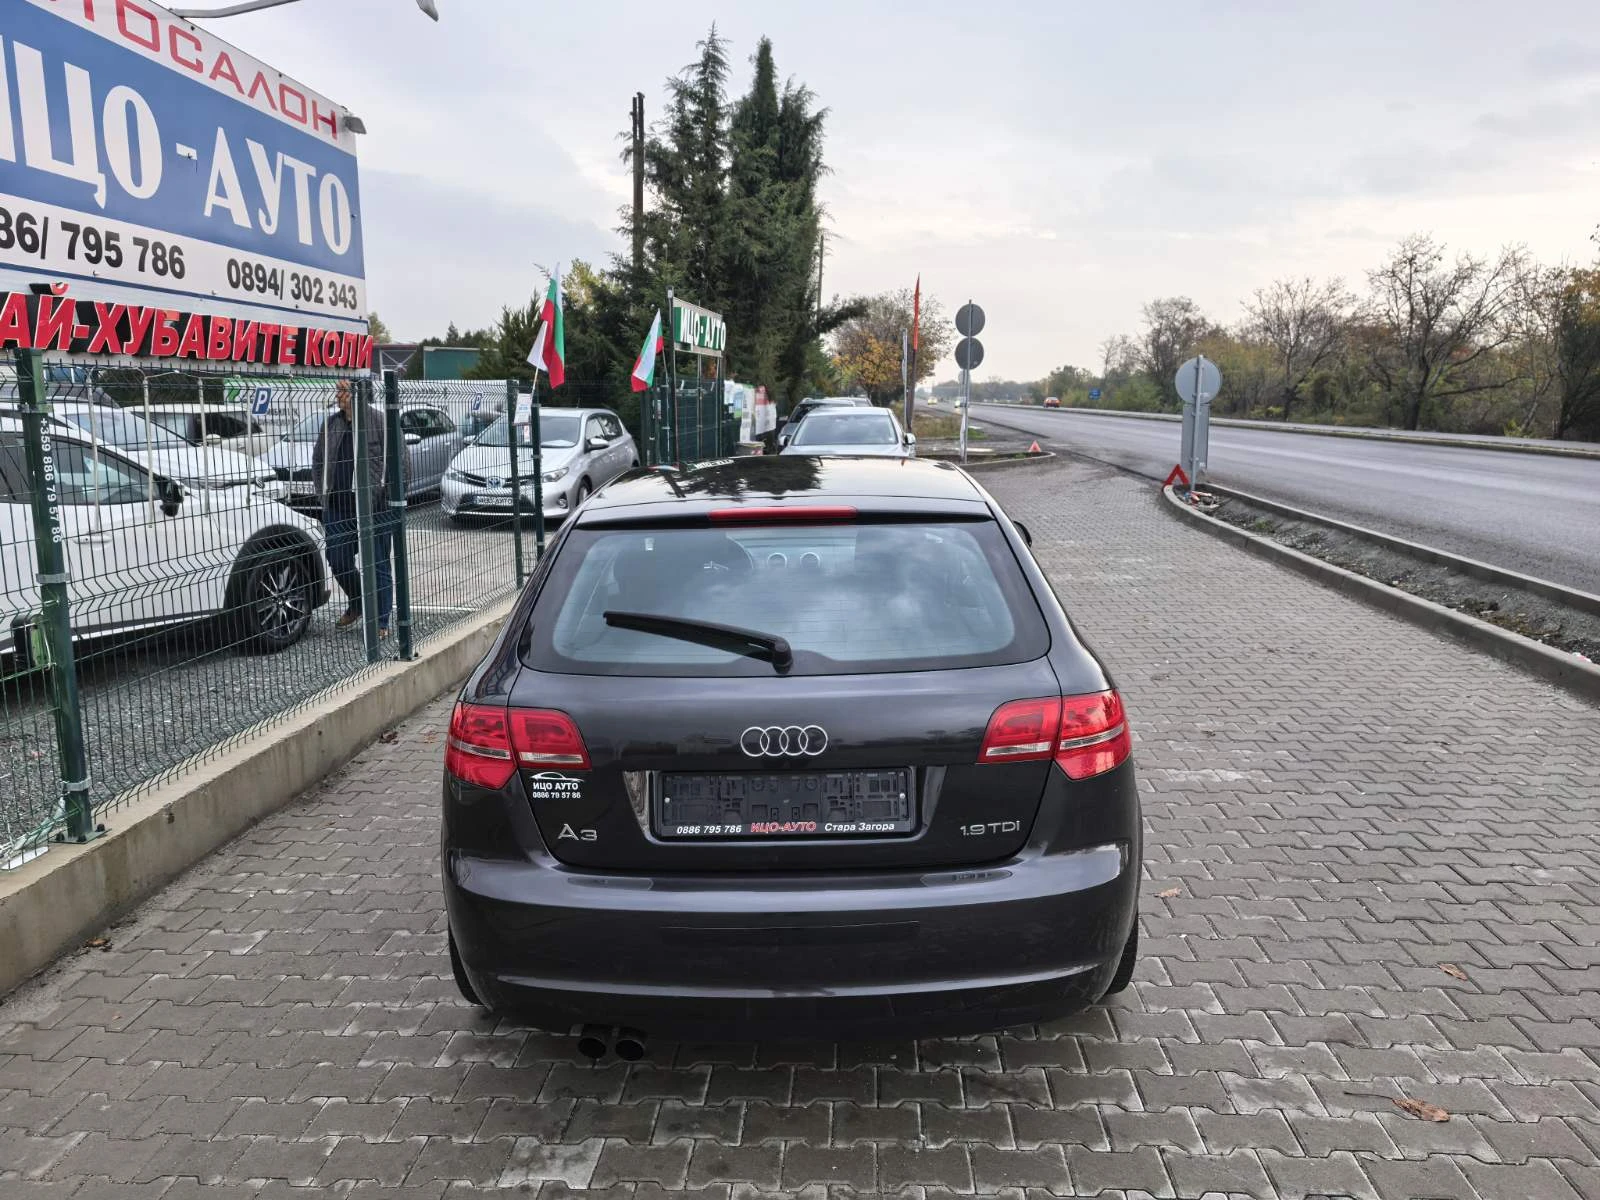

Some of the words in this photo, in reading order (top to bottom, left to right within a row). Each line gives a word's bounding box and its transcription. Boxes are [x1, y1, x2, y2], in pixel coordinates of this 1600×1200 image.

[61, 220, 123, 268] 795
[132, 236, 186, 279] 786
[227, 258, 285, 300] 0894/
[290, 272, 324, 304] 302
[329, 281, 358, 310] 343
[0, 283, 298, 366] АЙ-ХУБАВИТЕ
[304, 327, 374, 369] КОЛИ
[680, 306, 726, 351] ИЦО-АУТО
[41, 418, 51, 452] +359
[43, 456, 54, 481] 886
[46, 485, 57, 502] 79
[49, 506, 60, 522] 57
[51, 526, 62, 543] 86
[532, 782, 553, 791] ИЦО
[555, 782, 579, 790] АУТО
[557, 823, 598, 841] A3
[676, 825, 701, 834] 0886
[703, 825, 722, 834] 795
[724, 824, 742, 833] 786
[750, 821, 817, 834] ИЦО-АУТО
[824, 823, 856, 833] Стара
[858, 821, 895, 832] Загора
[960, 824, 986, 836] 1.9
